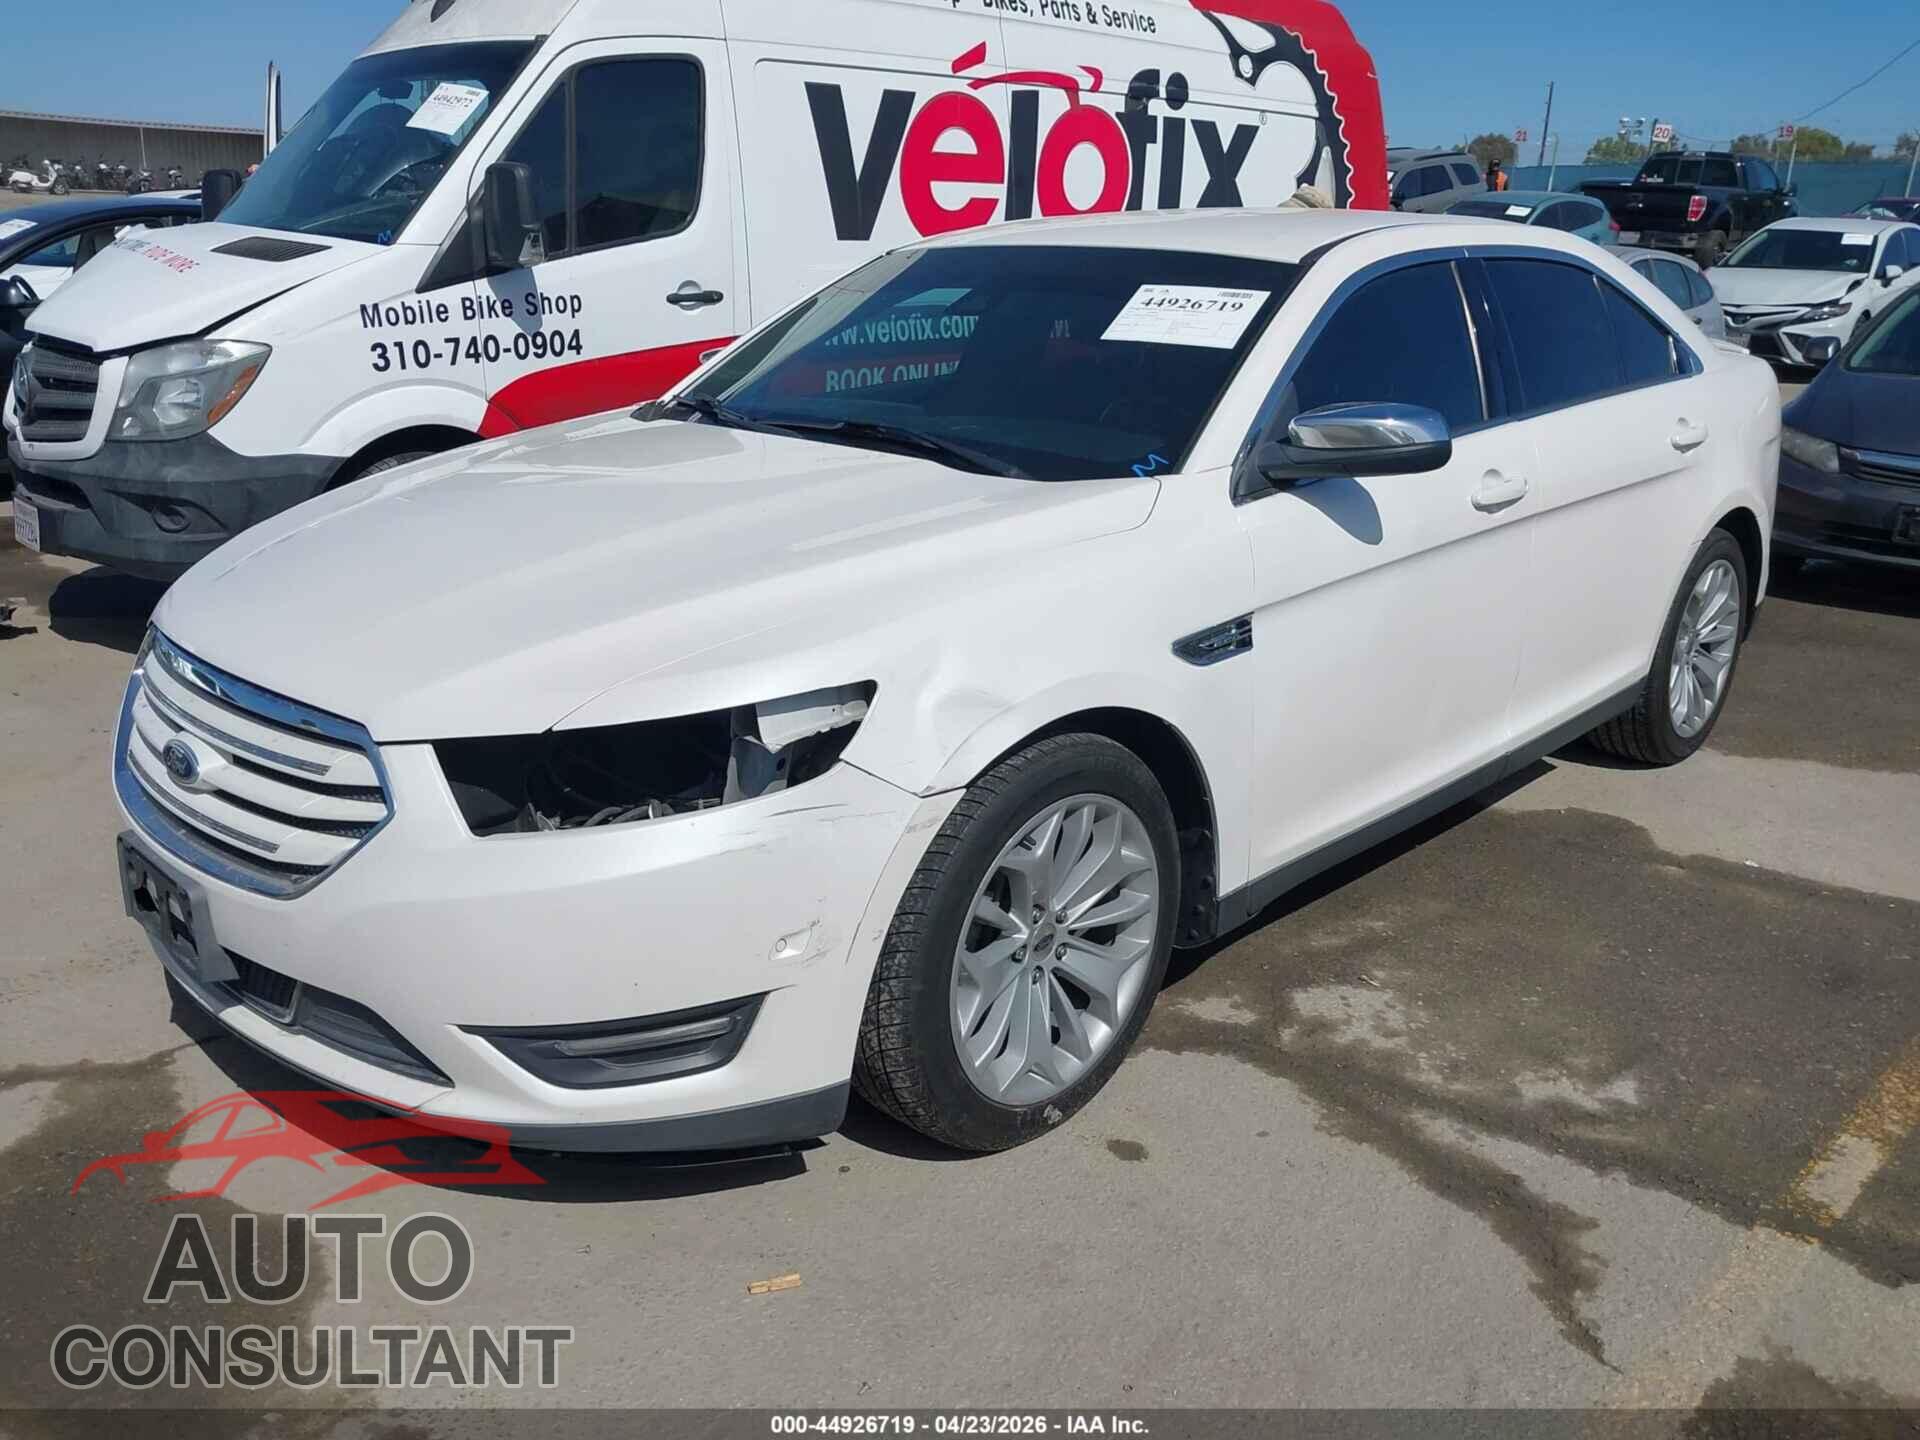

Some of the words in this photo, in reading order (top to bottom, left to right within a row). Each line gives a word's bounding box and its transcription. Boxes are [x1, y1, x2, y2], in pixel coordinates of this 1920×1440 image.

[1040, 0, 1082, 22] Parts
[1086, 6, 1099, 25] &
[1103, 5, 1157, 34] Service
[1655, 126, 1670, 139] 20
[360, 299, 449, 329] Mobile
[461, 296, 514, 321] Bike
[525, 292, 583, 318] Shop
[1140, 297, 1244, 313] 44926719
[370, 328, 583, 373] 310-740-0904
